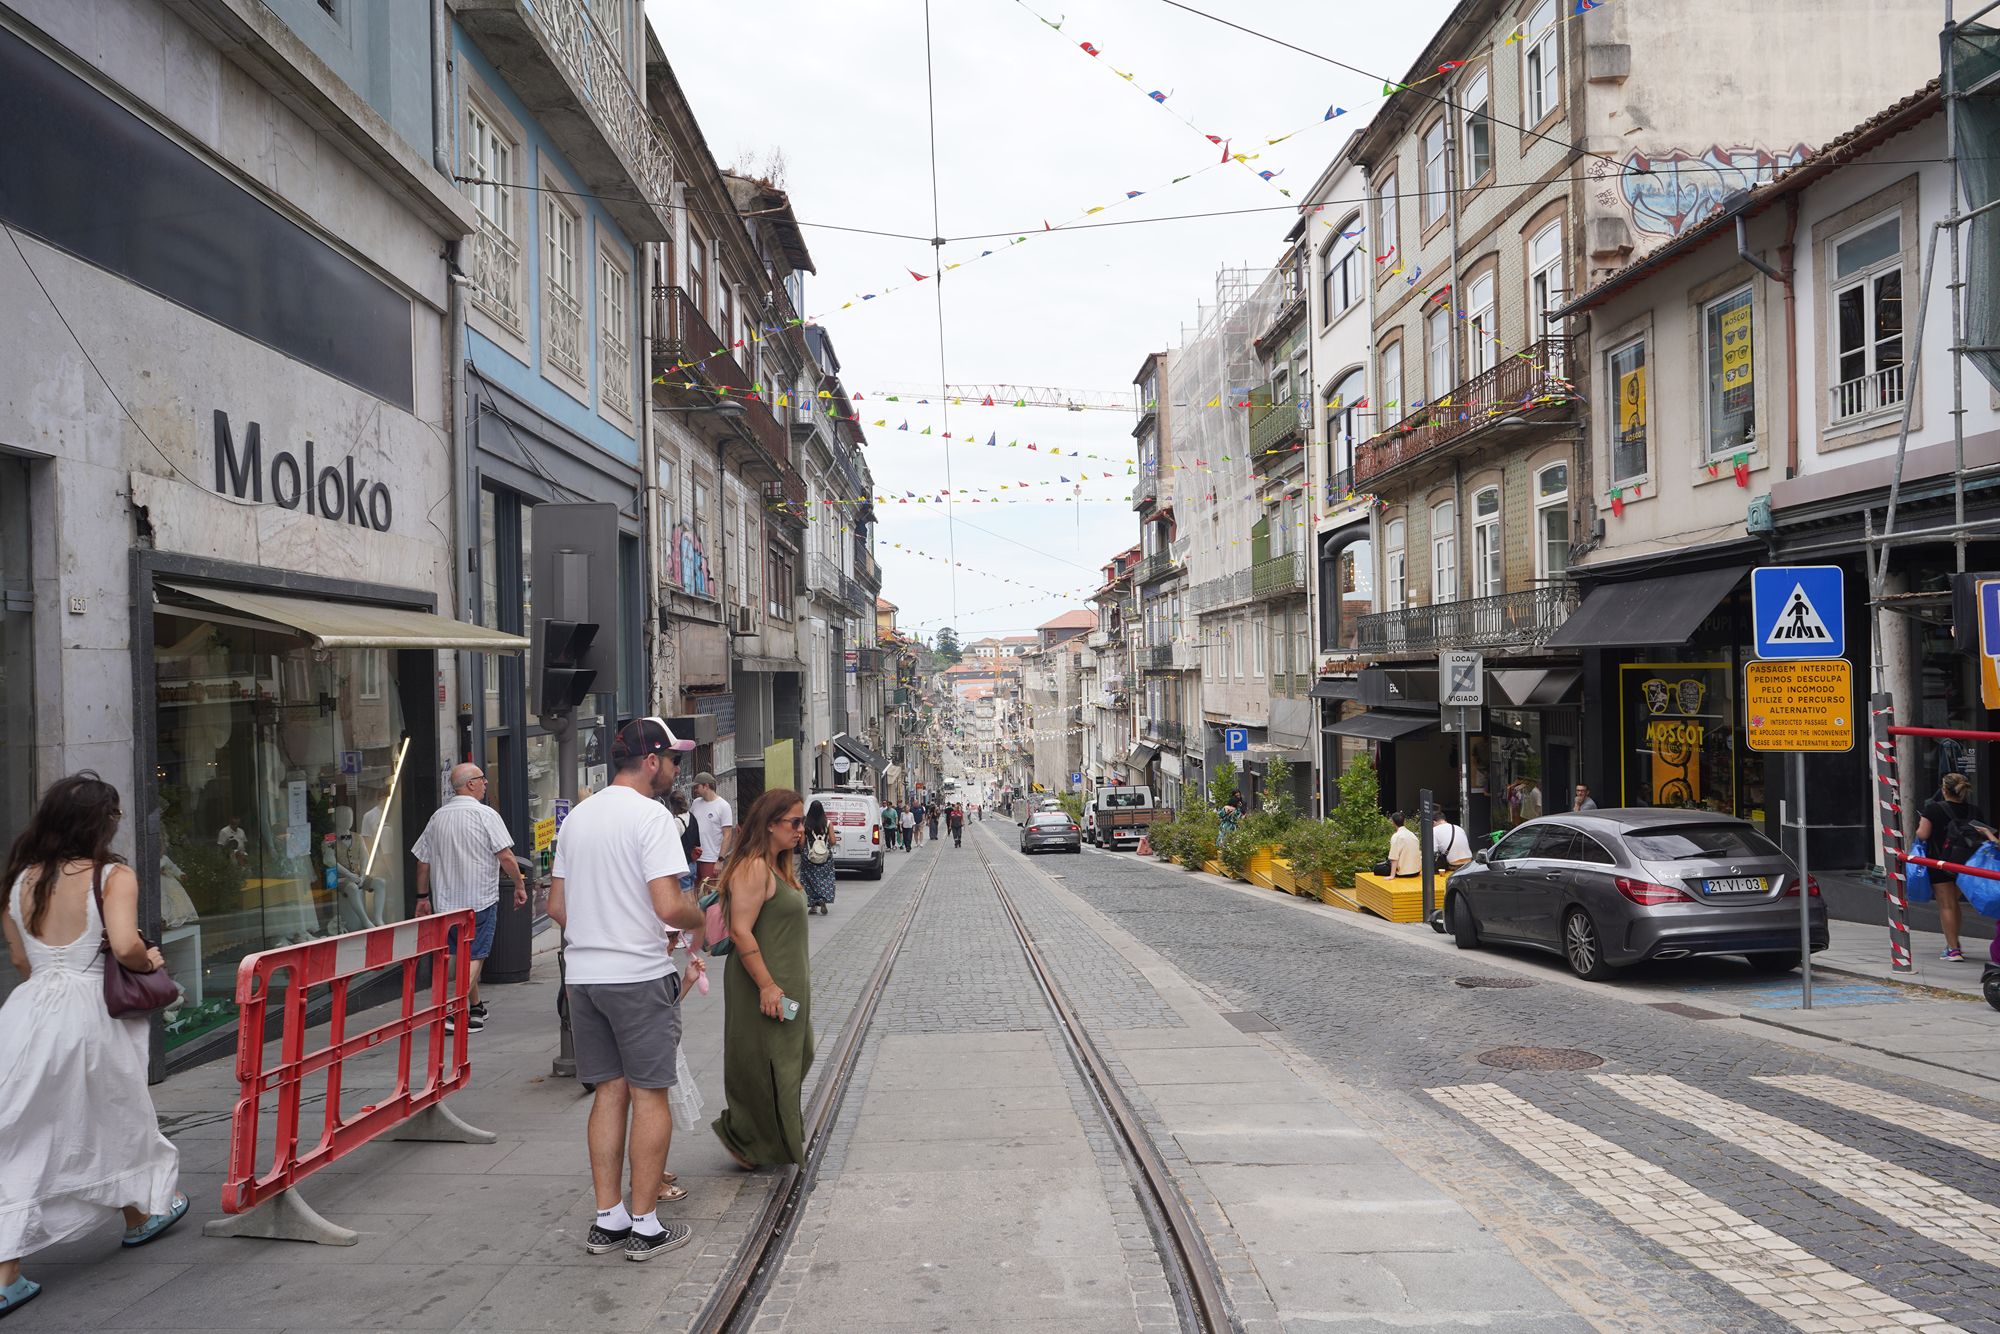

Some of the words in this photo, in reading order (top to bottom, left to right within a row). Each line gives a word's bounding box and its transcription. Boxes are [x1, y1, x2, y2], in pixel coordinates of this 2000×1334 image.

[1725, 311, 1748, 327] MOSCOT
[213, 409, 392, 532] Moloko
[1451, 655, 1475, 663] LOCAL
[1750, 665, 1796, 673] PASSAGEM
[1800, 664, 1846, 672] INTERDITA
[1754, 675, 1792, 683] PEDIMOS
[1796, 675, 1842, 683] DESCULPA
[1787, 684, 1835, 693] INCÓMODO
[1752, 696, 1783, 704] UTILIZE
[1787, 696, 1794, 704] O
[1798, 696, 1845, 704] PERCURSO
[1769, 706, 1828, 714] ALTERNATIVO
[1646, 722, 1705, 746] MOSCOT
[1230, 731, 1243, 750] P
[1796, 739, 1829, 747] ALTERNATIVE
[1831, 739, 1848, 747] ROUTE
